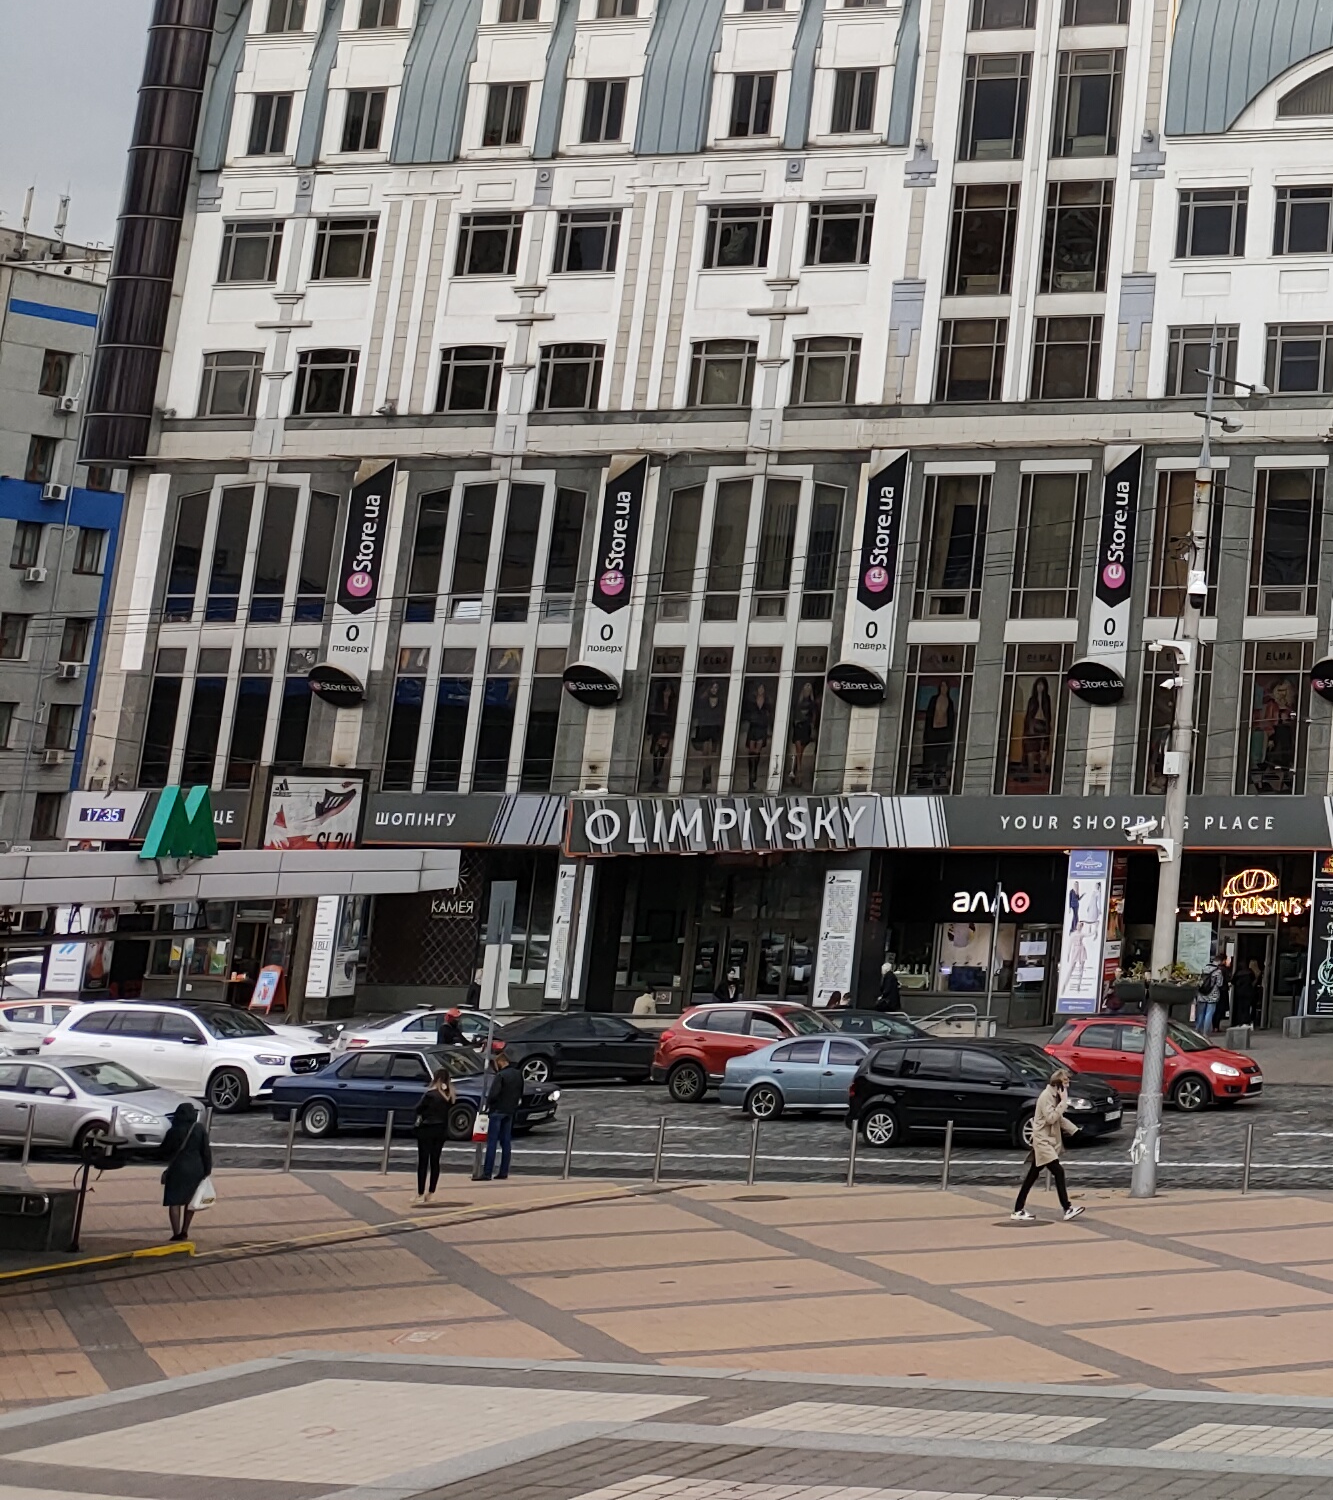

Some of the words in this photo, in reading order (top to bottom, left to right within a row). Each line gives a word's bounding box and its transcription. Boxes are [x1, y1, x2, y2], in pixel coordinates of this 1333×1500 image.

[350, 494, 381, 592] eStore.ua
[603, 490, 632, 590] eStore.ua
[867, 485, 896, 587] eStore.ua
[1105, 480, 1130, 583] eStore.ua
[1104, 617, 1116, 636] 0
[86, 808, 120, 822] 17:35
[375, 812, 456, 826] ШОПІНГУ
[585, 805, 866, 845] OLIMPIYSKY
[1000, 815, 1059, 830] YOUR
[1204, 816, 1275, 830] PLACE
[431, 900, 474, 914] КАМЕЯ
